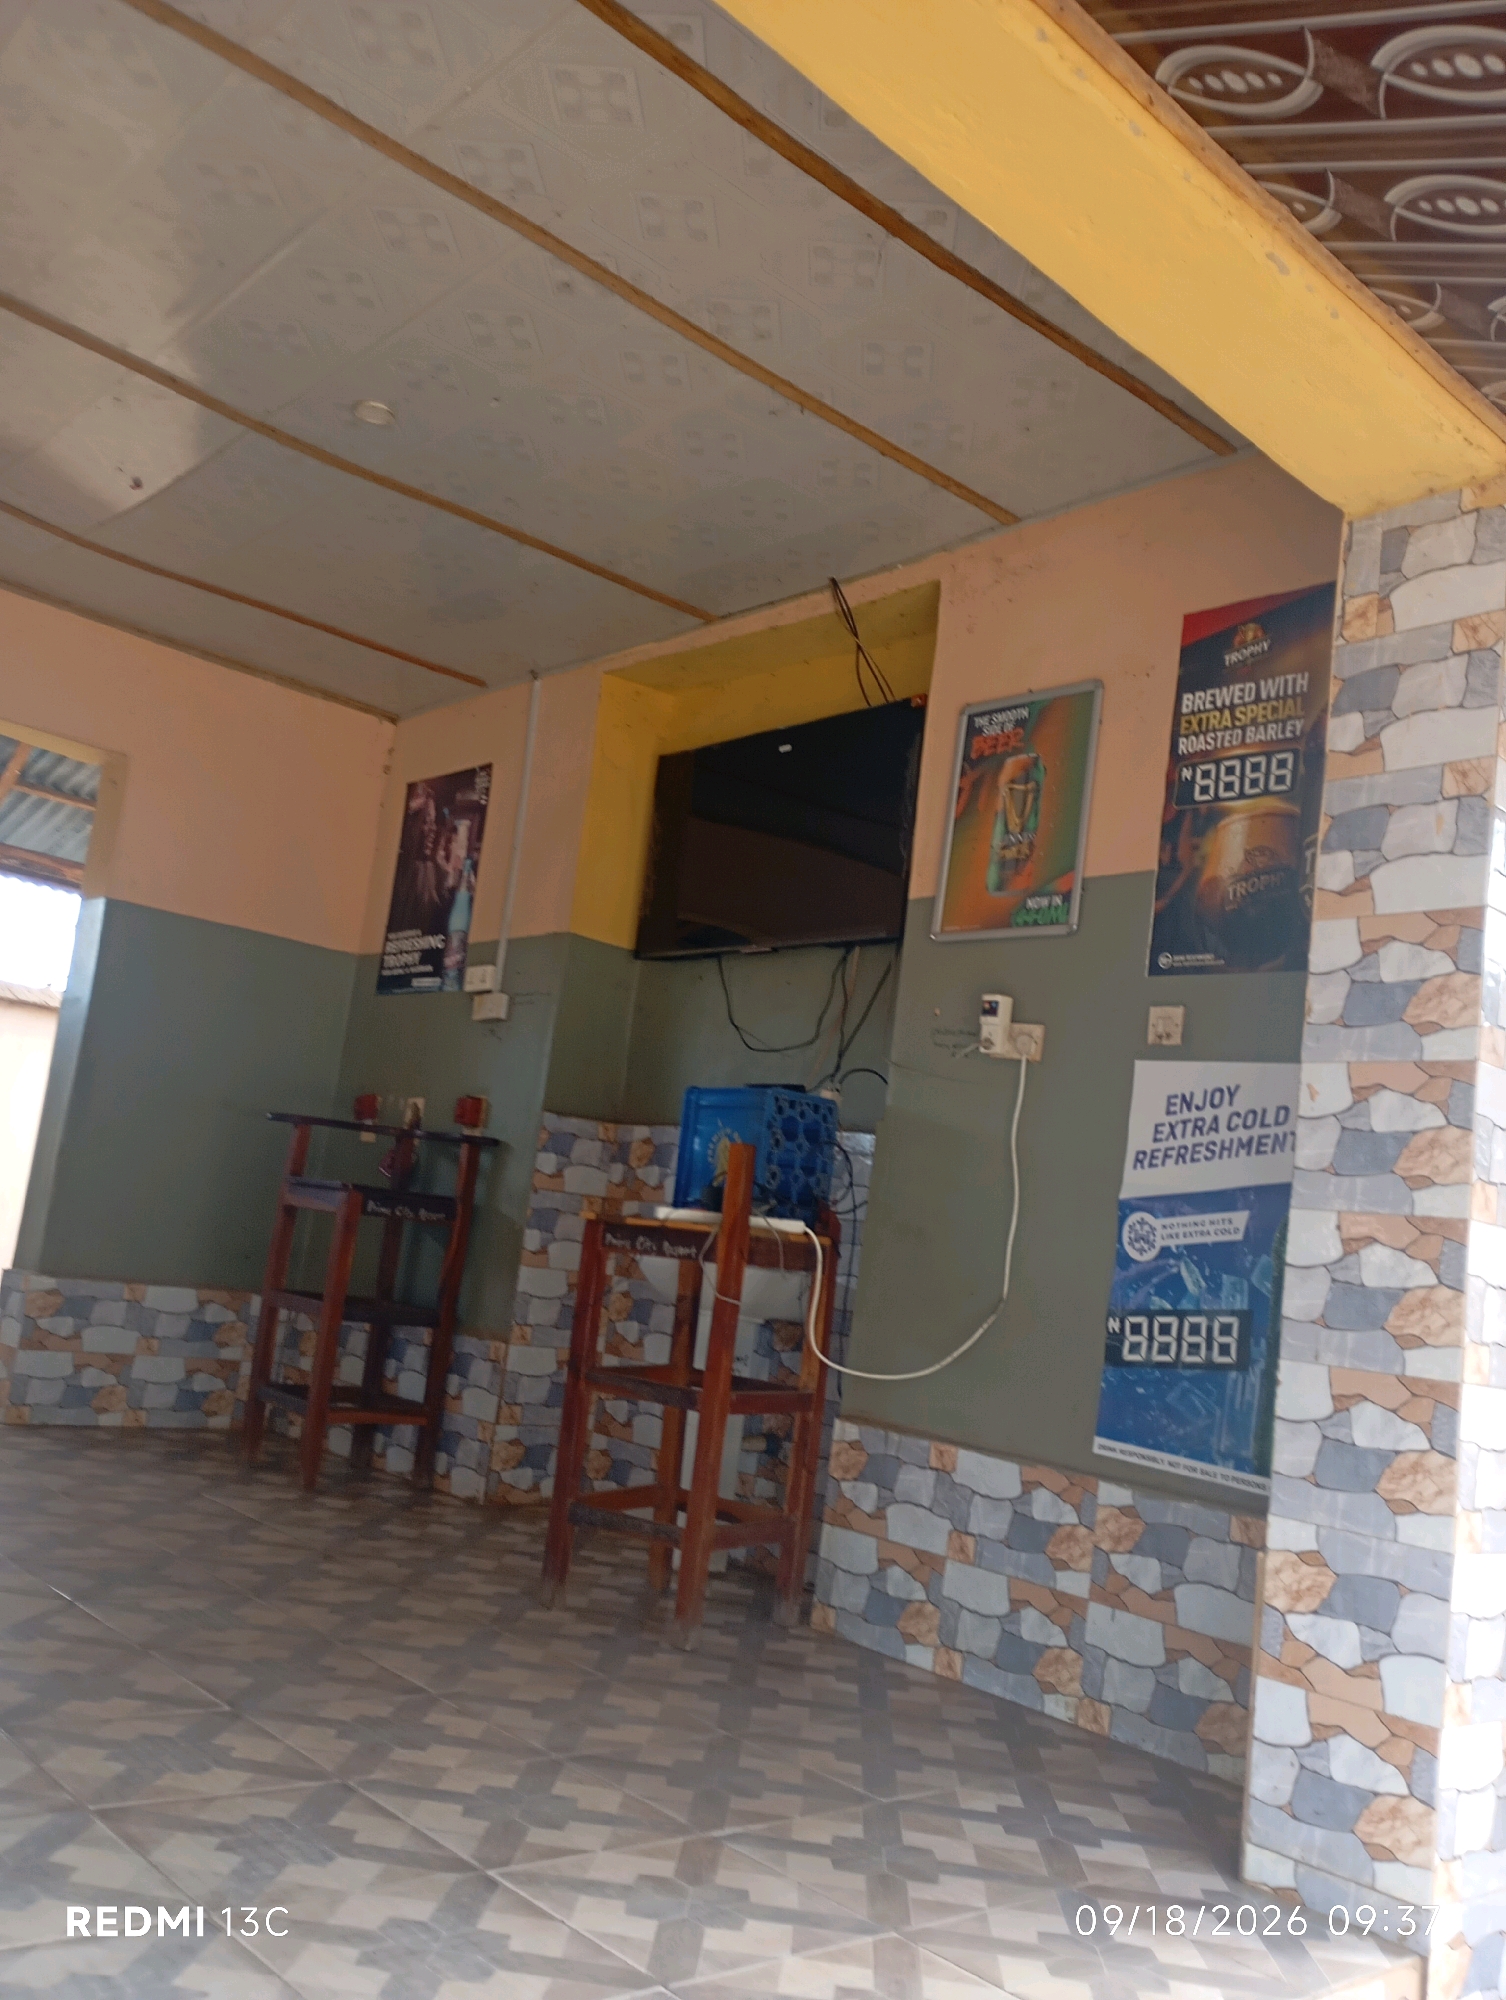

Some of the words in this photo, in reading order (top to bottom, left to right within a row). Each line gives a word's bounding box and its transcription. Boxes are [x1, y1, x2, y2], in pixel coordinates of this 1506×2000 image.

[1224, 639, 1271, 667] TROPHY
[1181, 682, 1256, 714] BREWED
[1259, 672, 1309, 699] WITH
[1180, 709, 1232, 735] EXTRA
[1234, 698, 1305, 727] SPECIAL
[1178, 729, 1242, 756] ROASTED
[1245, 718, 1305, 744] BARLEY
[1165, 1084, 1241, 1116] ENJOY
[1152, 1114, 1220, 1144] EXTRA
[1226, 1105, 1290, 1132] COLD
[1161, 1219, 1206, 1230] NOTHING
[1208, 1217, 1233, 1226] HITS
[1161, 1232, 1180, 1241] LIKE
[1182, 1229, 1211, 1239] EXTRA
[1213, 1227, 1240, 1237] COLD
